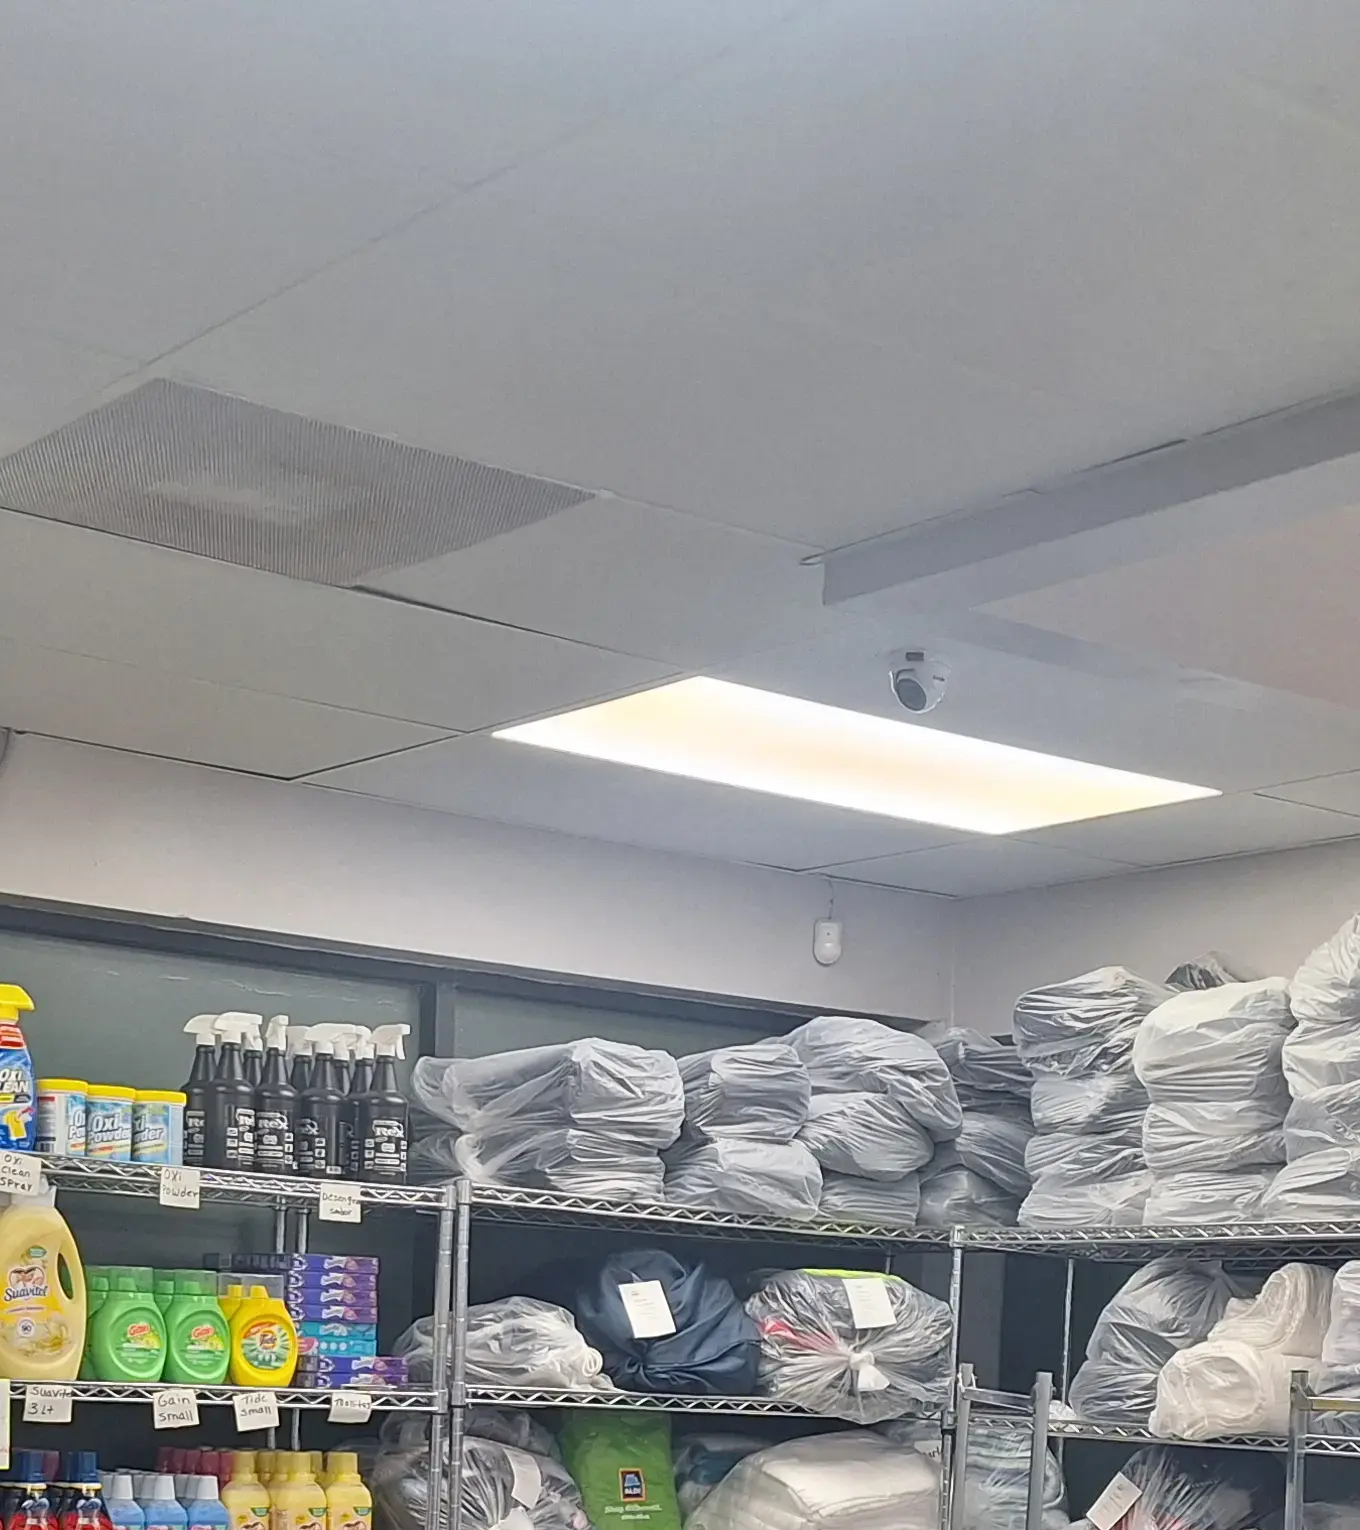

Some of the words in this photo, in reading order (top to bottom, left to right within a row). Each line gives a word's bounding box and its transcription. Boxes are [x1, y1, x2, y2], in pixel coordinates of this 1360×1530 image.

[157, 1393, 191, 1408] Gain
[27, 1402, 39, 1415] 3
[240, 1406, 272, 1417] small
[158, 1410, 194, 1422] small
